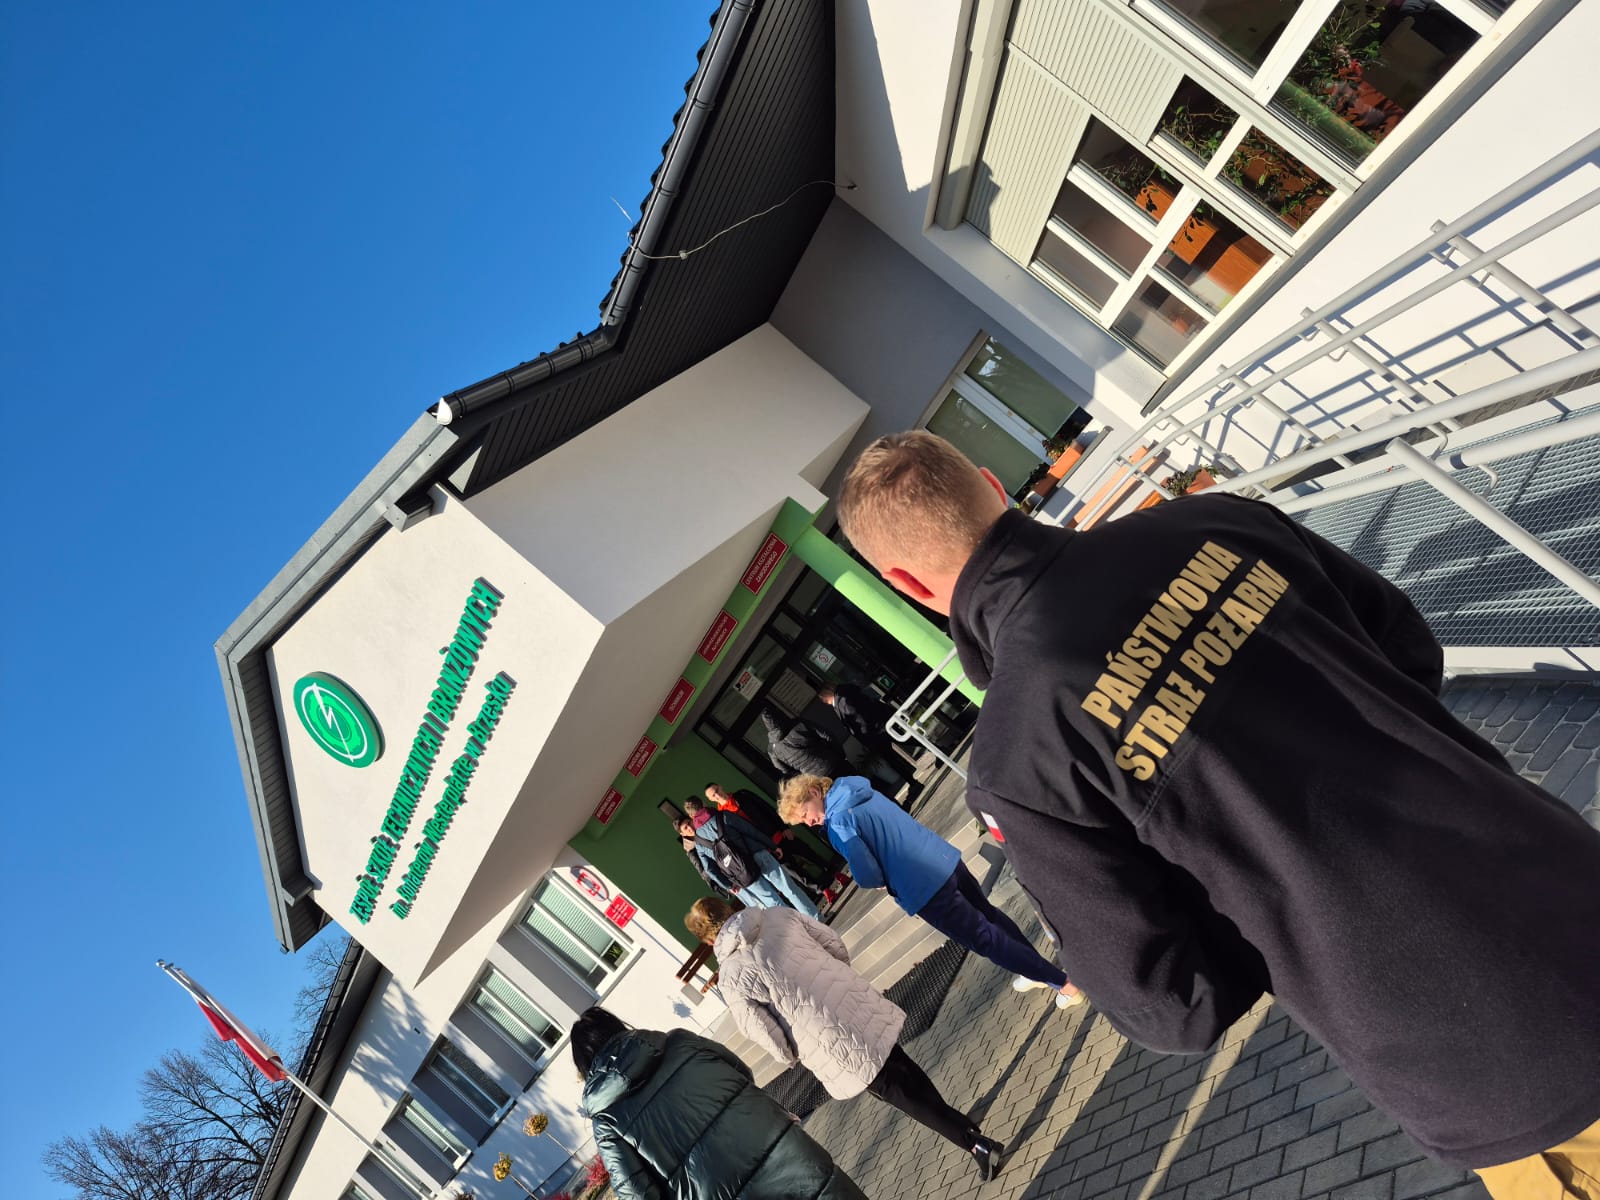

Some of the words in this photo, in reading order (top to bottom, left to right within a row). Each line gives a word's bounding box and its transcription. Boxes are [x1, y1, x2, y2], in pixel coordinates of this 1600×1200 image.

[427, 577, 504, 723] BRANŻOWYCH
[1081, 540, 1243, 729] PAŃSTWOWA
[423, 712, 449, 734] I
[466, 671, 517, 744] Brzesku
[1114, 670, 1206, 781] STRAŻ
[381, 722, 445, 842] TECHNICZNYCH
[464, 736, 487, 759] w
[422, 753, 479, 843] Westerplatte
[366, 834, 400, 883] SZKÓŁ
[396, 837, 440, 903] Bohaterów
[349, 874, 384, 925] ZESPÓŁ
